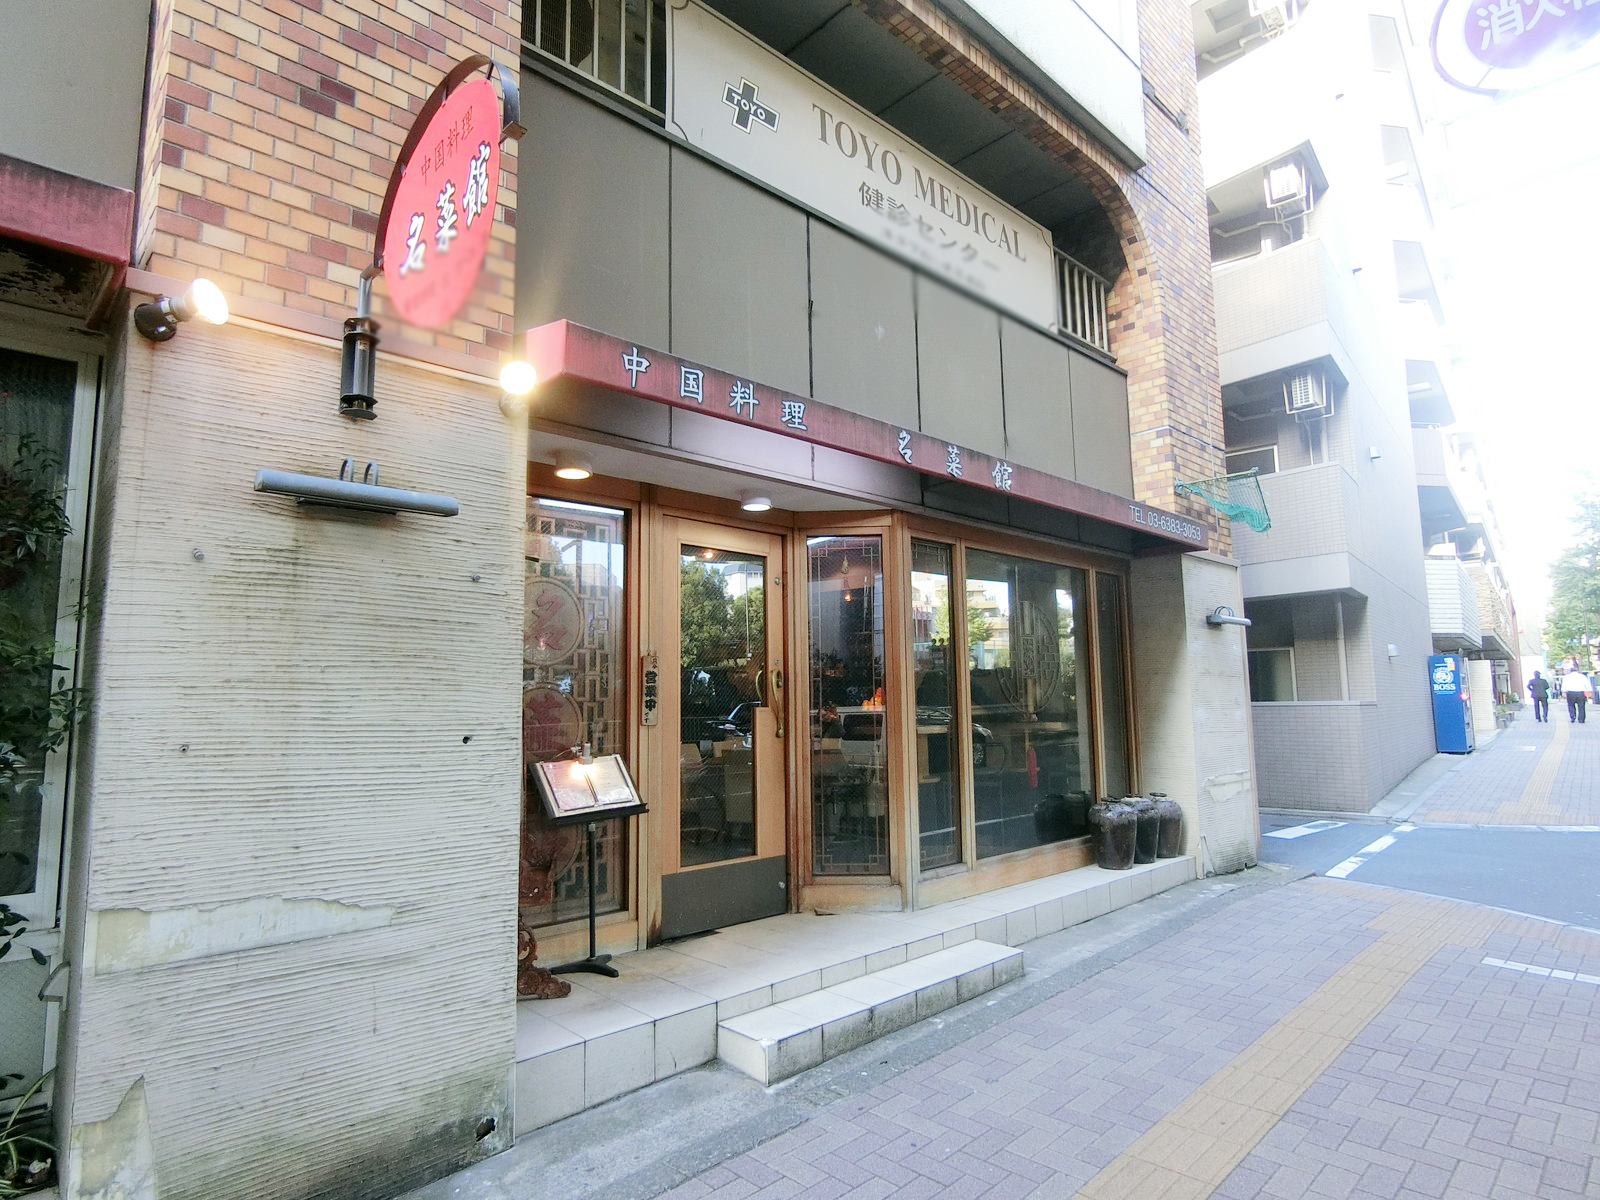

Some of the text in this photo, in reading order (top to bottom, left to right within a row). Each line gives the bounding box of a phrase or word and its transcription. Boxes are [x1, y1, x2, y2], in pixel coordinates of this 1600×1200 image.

[1475, 0, 1600, 51] 消火
[420, 105, 474, 186] 中国料理
[731, 92, 766, 120] TOYO
[399, 140, 492, 276] 名菜館
[811, 103, 902, 186] TOYO
[912, 166, 1027, 263] MEDICAL
[858, 180, 1001, 272] 健診センター
[621, 346, 1014, 492] 中国料理 名菜館
[1129, 505, 1201, 540] TEL 03-6383-3053
[1433, 683, 1456, 691] BOSS
